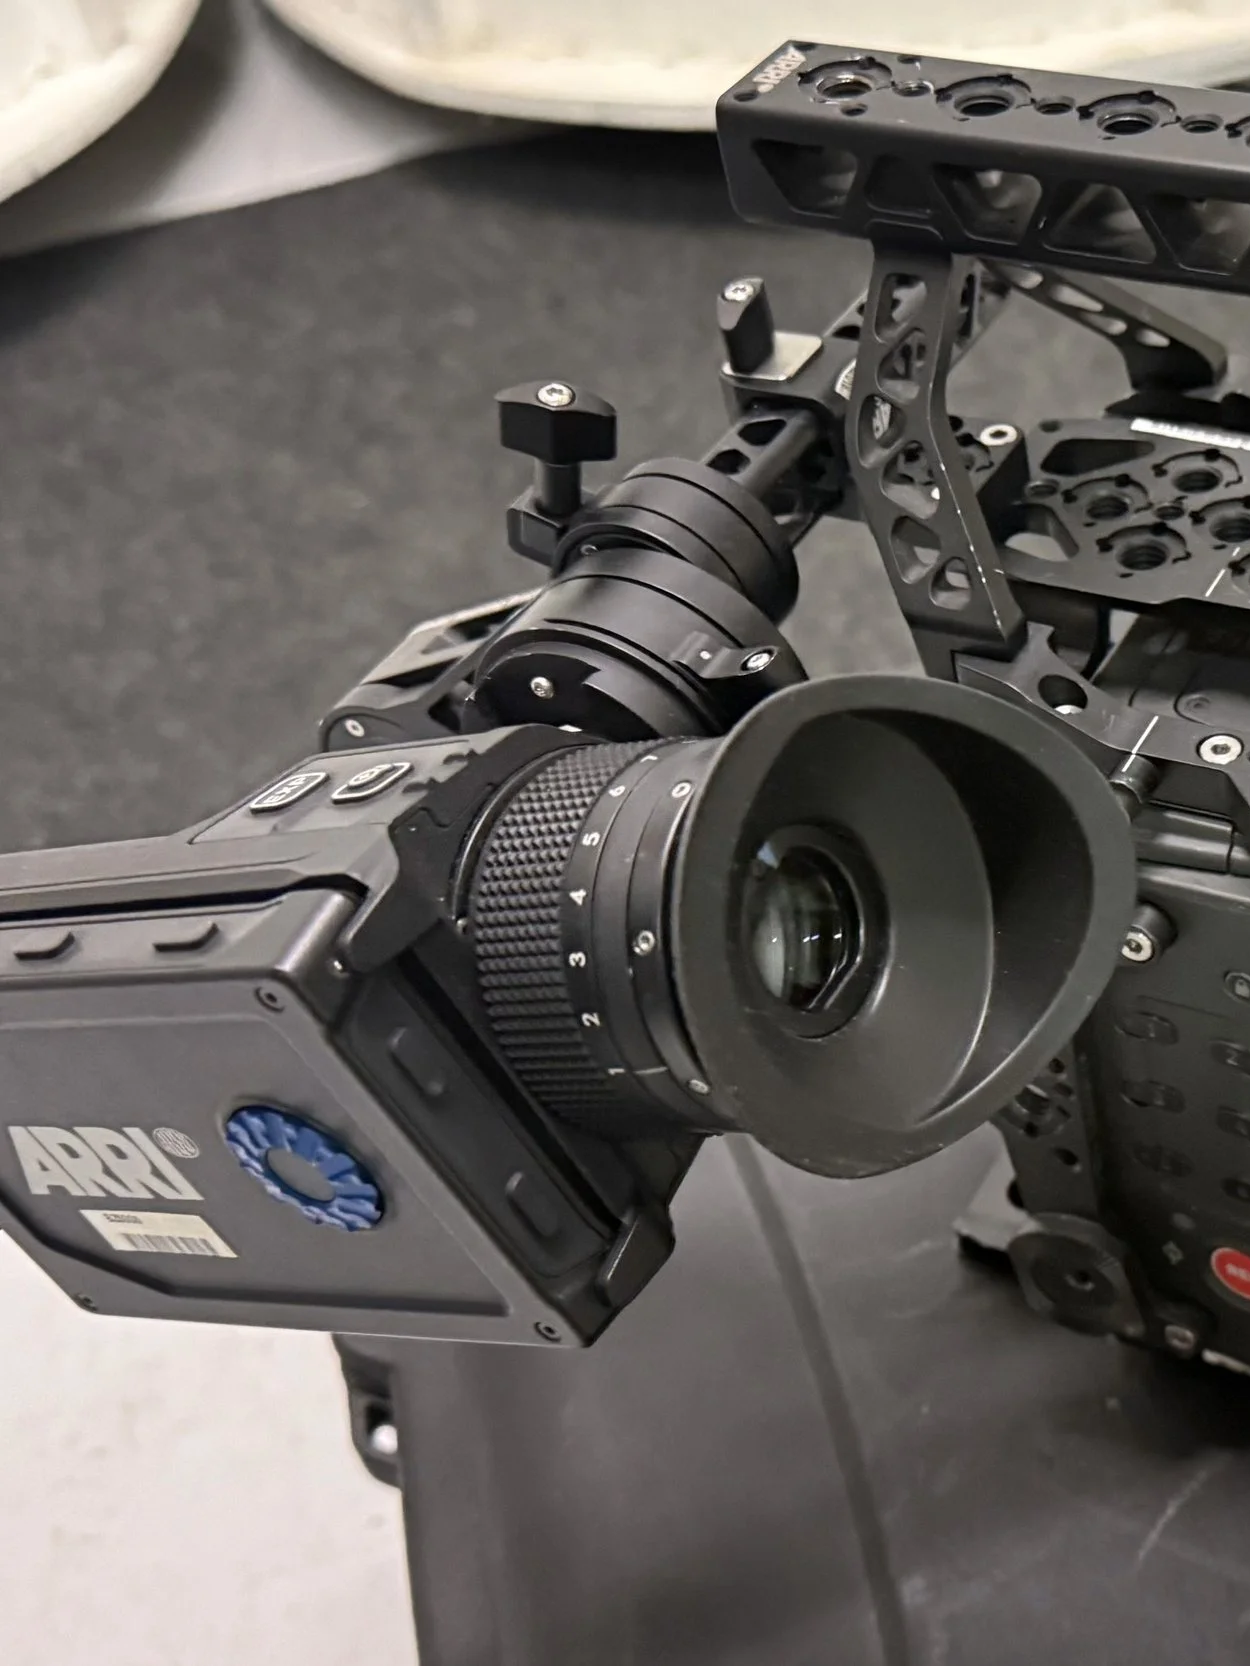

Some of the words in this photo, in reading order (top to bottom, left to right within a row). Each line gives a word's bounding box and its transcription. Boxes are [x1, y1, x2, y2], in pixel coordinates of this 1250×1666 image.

[752, 44, 806, 85] ARRI
[264, 777, 307, 804] EXP
[608, 785, 626, 797] 6
[582, 832, 600, 846] 5
[569, 888, 587, 906] 4
[568, 951, 586, 968] 3
[581, 1012, 601, 1027] 2
[607, 1067, 625, 1076] 1
[8, 1126, 205, 1201] ARRI
